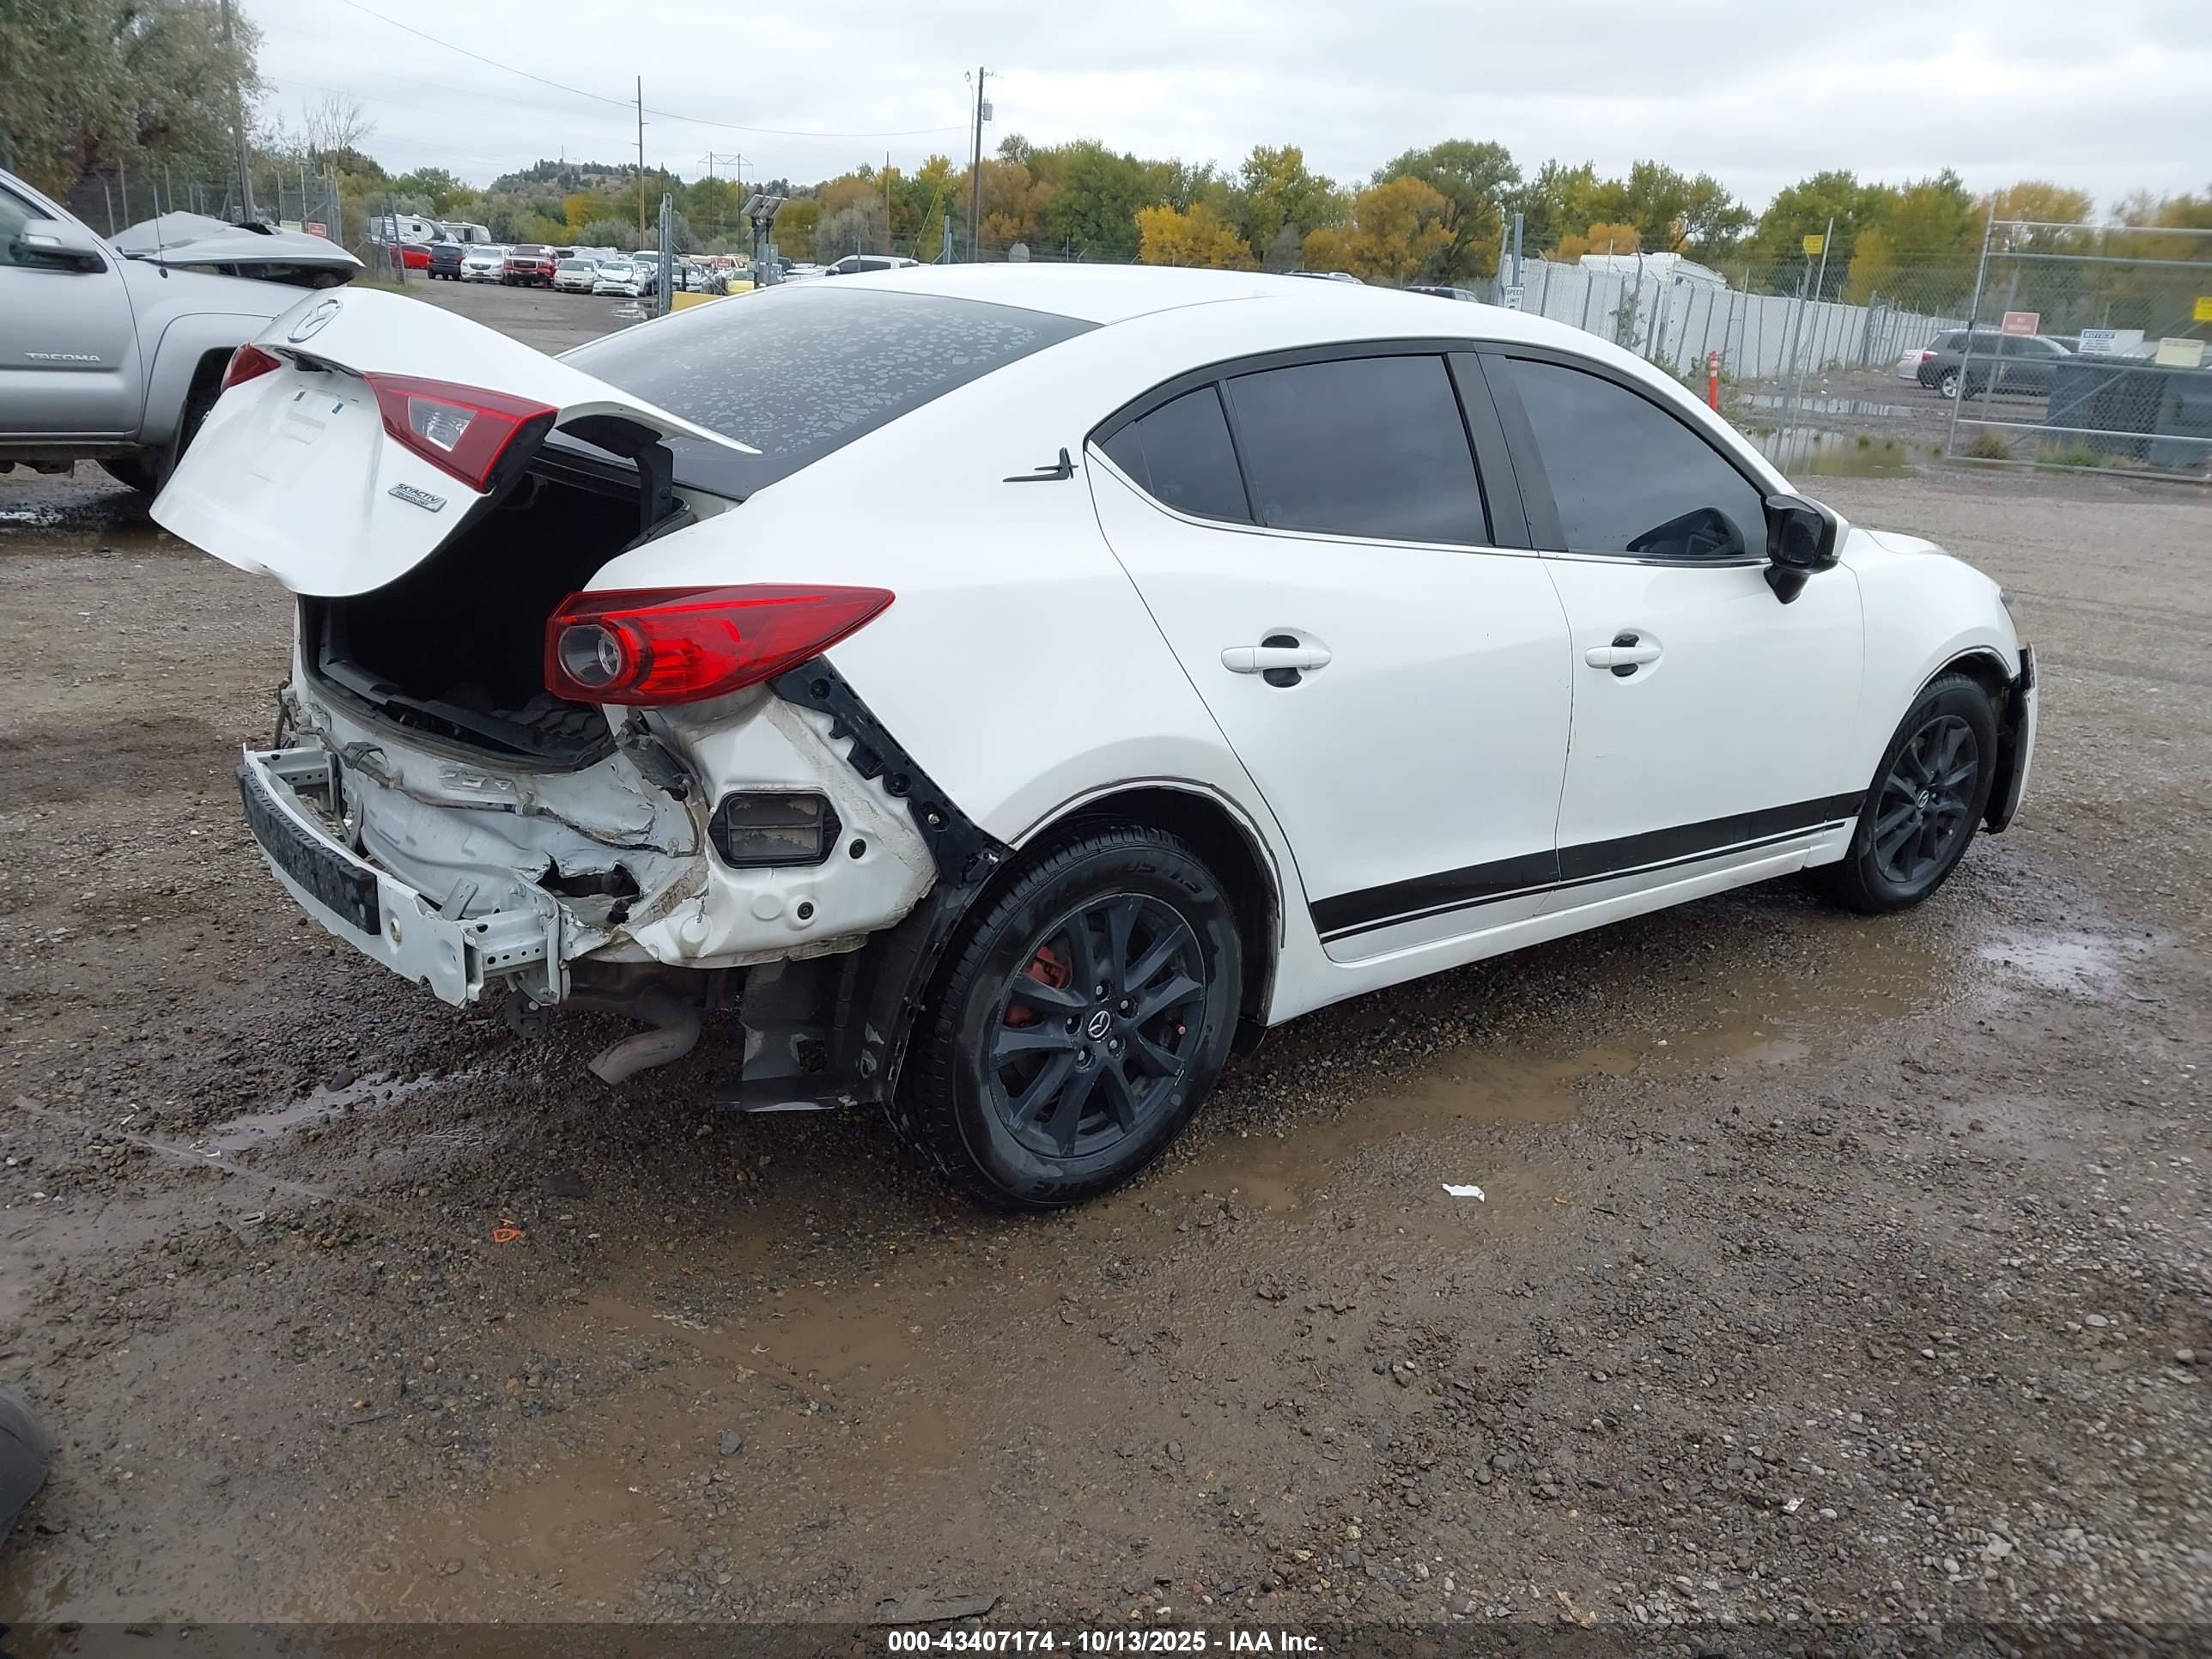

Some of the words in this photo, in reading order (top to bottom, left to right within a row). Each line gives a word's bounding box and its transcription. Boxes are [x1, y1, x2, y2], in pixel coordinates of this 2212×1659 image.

[24, 352, 100, 362] TACOMA
[395, 490, 429, 506] TECHNOLOGY
[397, 483, 441, 501] SKYACTIV
